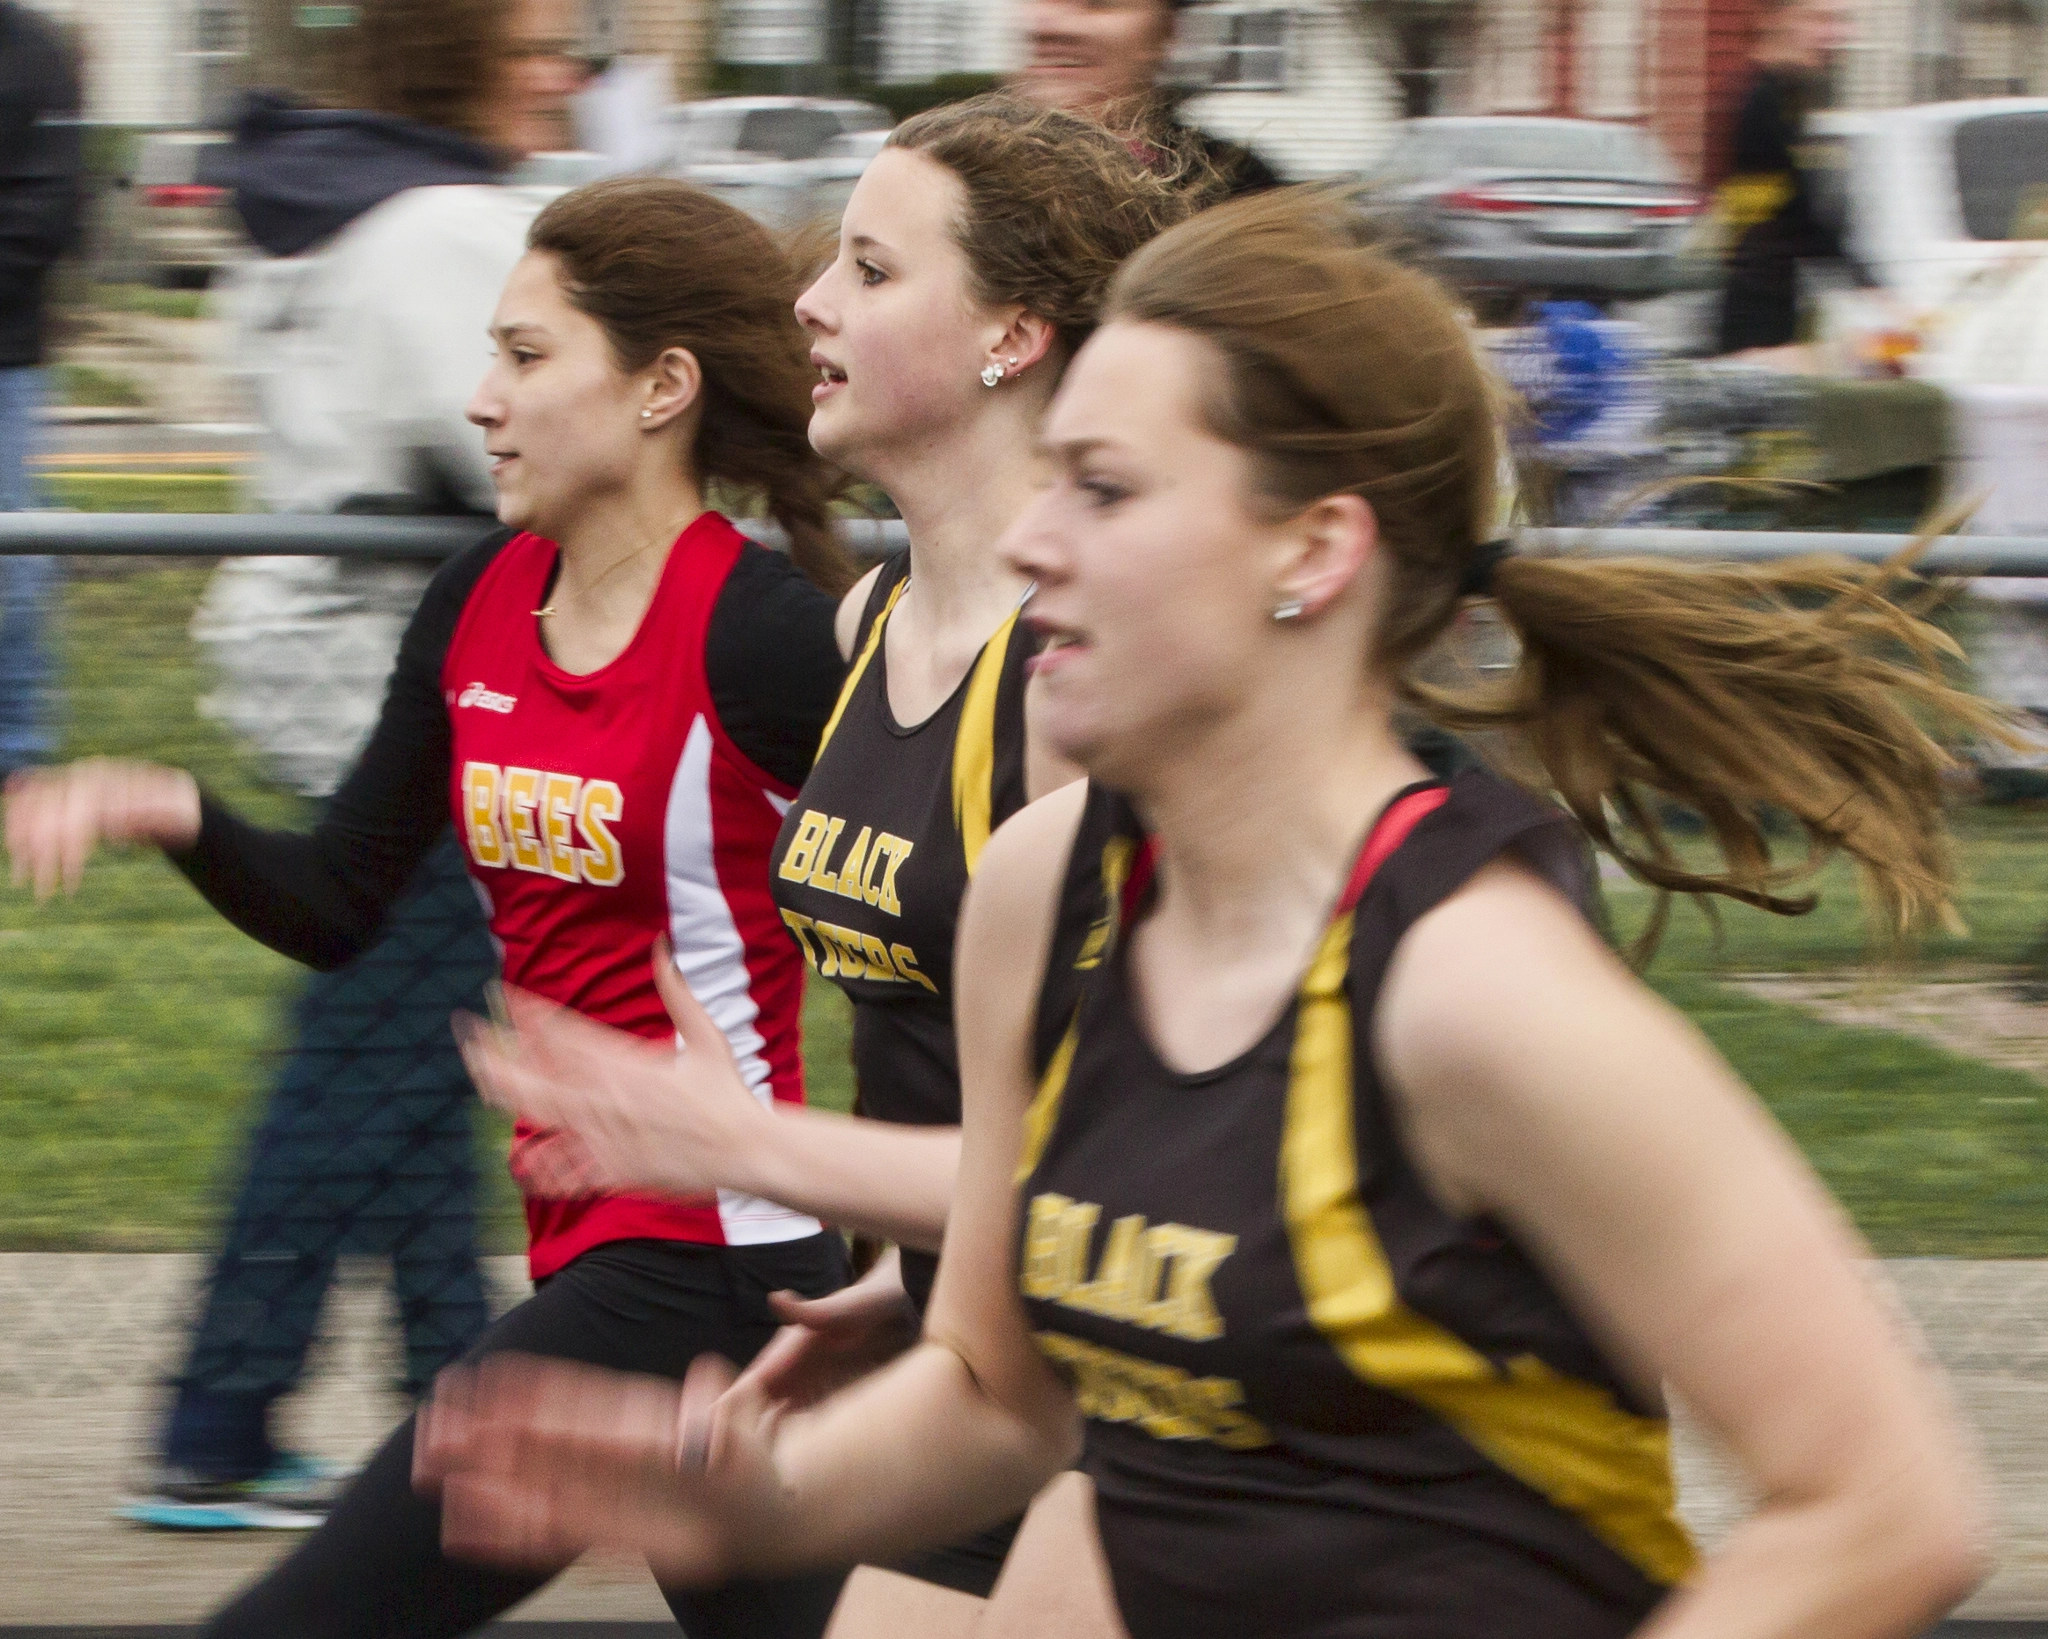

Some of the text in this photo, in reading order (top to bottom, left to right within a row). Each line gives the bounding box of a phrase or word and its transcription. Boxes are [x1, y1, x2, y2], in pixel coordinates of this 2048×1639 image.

[462, 761, 626, 887] BEES
[779, 809, 914, 917] BLACK
[1021, 1192, 1239, 1343] BLACK
